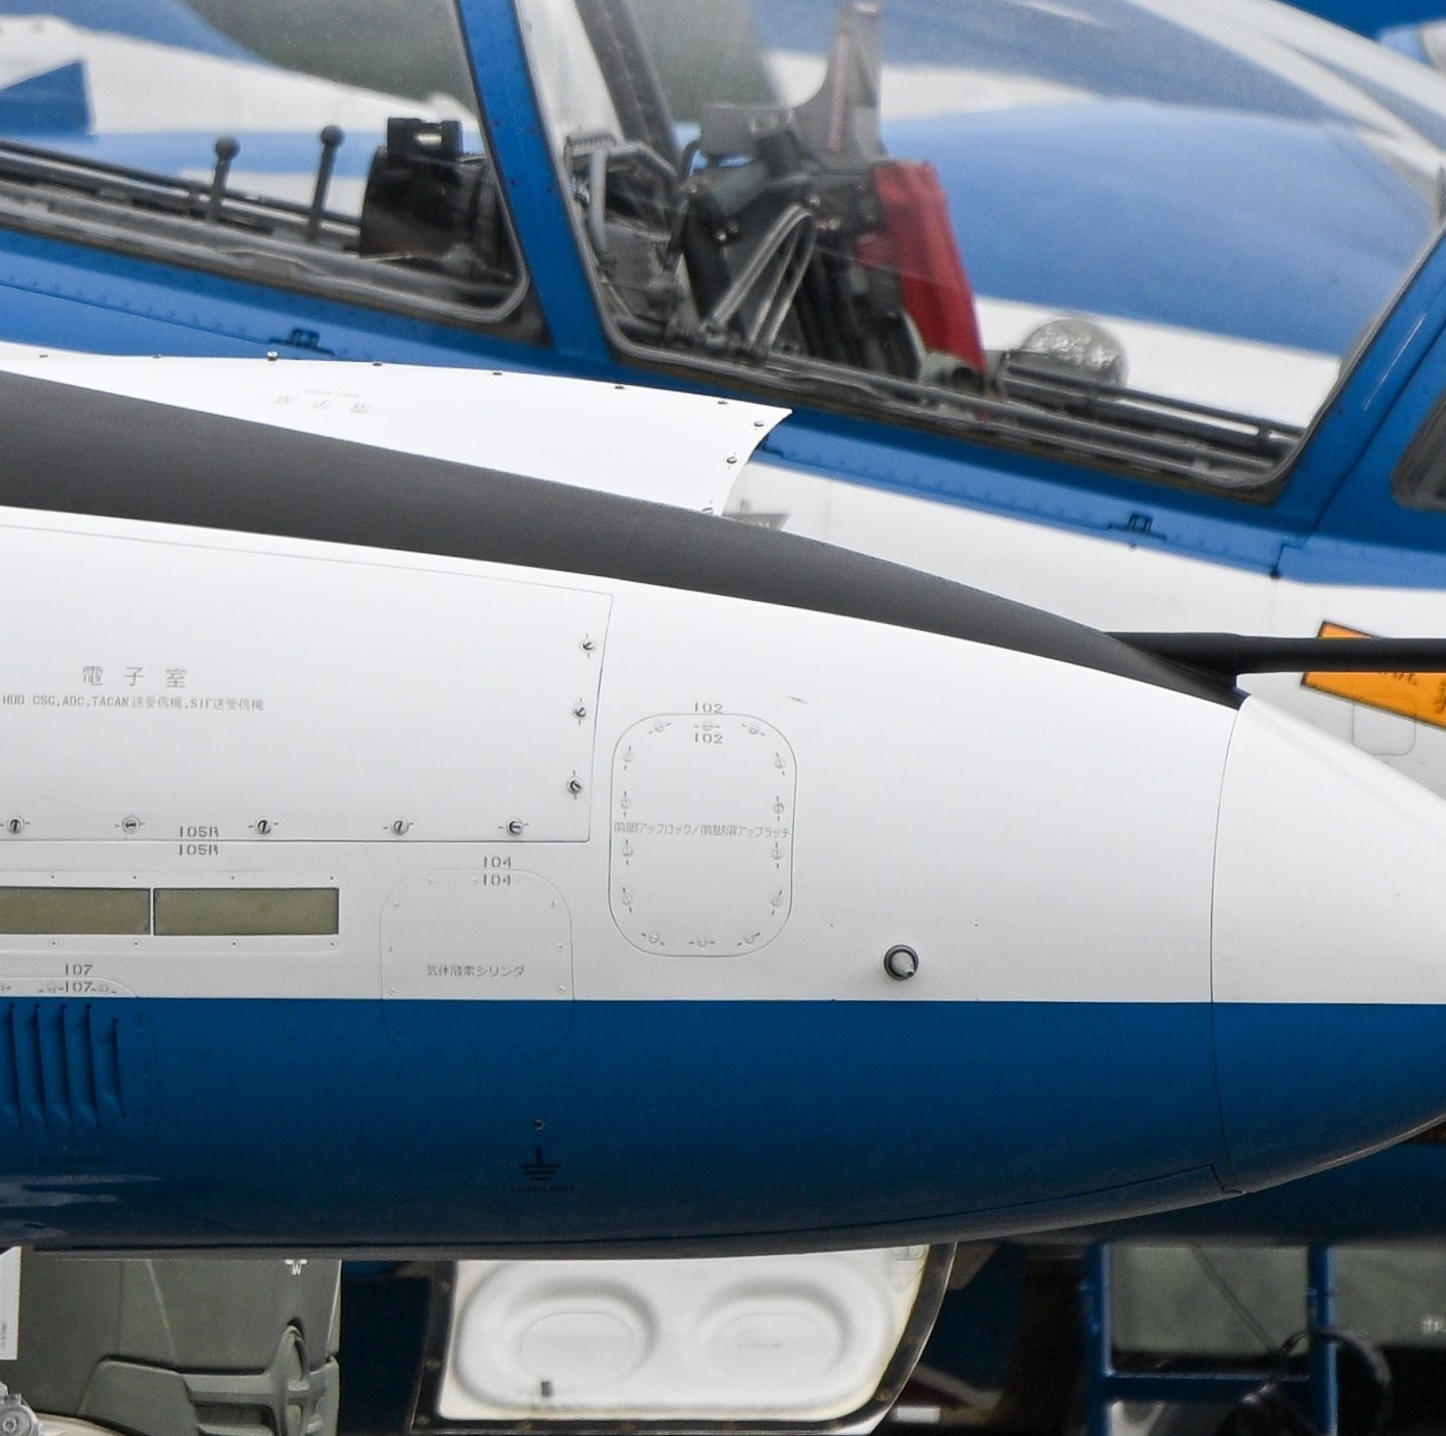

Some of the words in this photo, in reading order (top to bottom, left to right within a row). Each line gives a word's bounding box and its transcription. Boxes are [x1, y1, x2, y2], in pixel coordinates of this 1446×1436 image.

[694, 702, 724, 714] 102
[694, 732, 724, 745] 102
[483, 856, 512, 868] 104
[482, 874, 512, 887] 104
[64, 964, 94, 976] 107
[63, 981, 93, 994] 107
